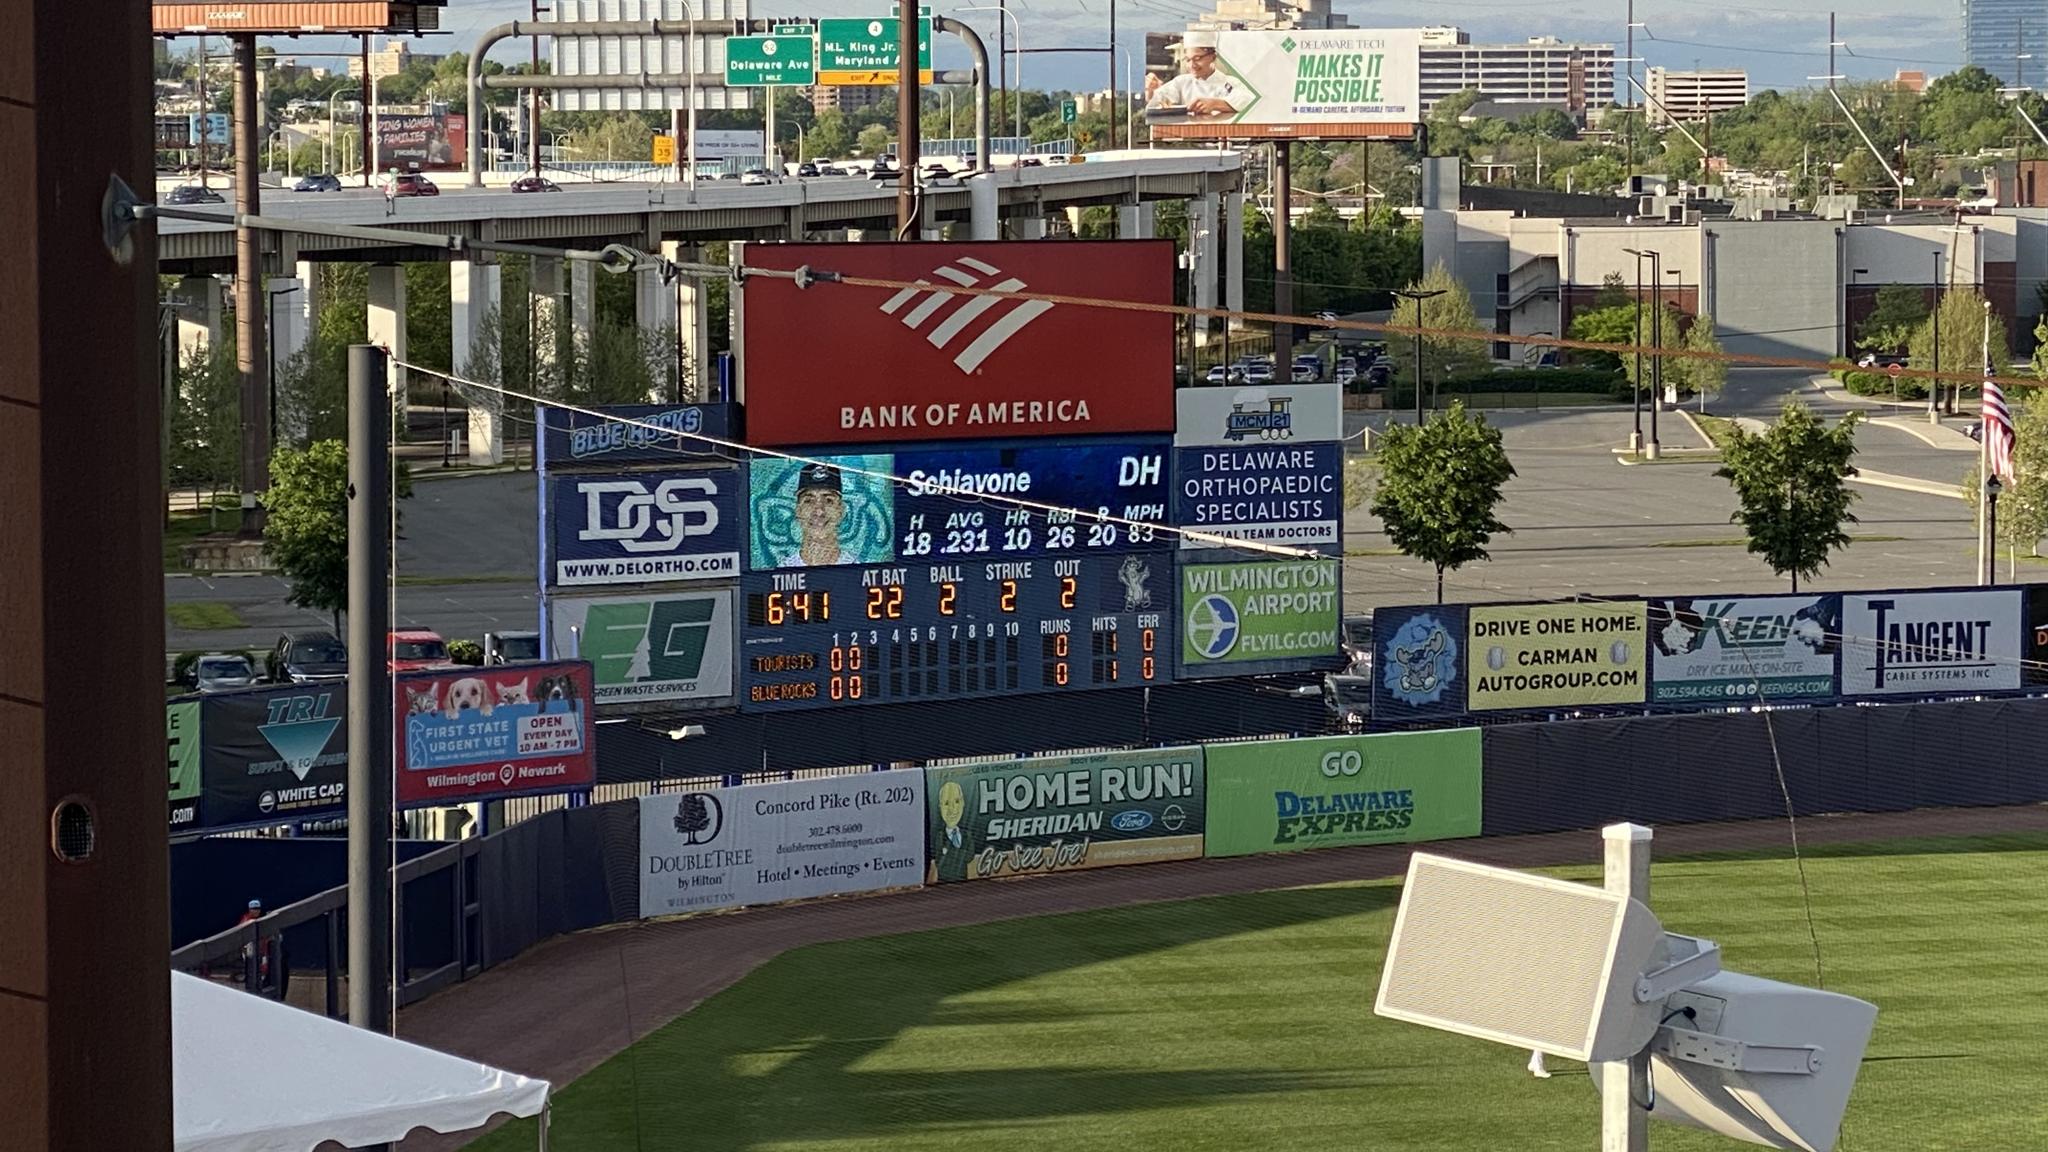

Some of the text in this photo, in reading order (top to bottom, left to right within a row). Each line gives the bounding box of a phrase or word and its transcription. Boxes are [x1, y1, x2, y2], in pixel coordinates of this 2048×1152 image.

[850, 42, 876, 54] King
[881, 42, 896, 52] Jr.
[1300, 39, 1385, 50] DELAWARE TECH
[731, 59, 809, 70] Delaware Ave
[835, 55, 889, 67] Maryland
[1297, 54, 1384, 78] MAKES IT
[759, 73, 763, 82] 1
[1294, 79, 1384, 103] POSSIBLE.
[403, 116, 435, 129] WOMEN
[384, 131, 426, 144] FAMILIES
[657, 148, 671, 157] 35
[840, 400, 1091, 429] BANK OF AMERICA
[1236, 415, 1287, 427] MCM 21
[572, 408, 700, 456] BLUE ROCKS
[1203, 450, 1315, 472] DELAWARE
[907, 455, 1162, 496] Schiavone DH
[1184, 474, 1333, 498] ORTHOPAEDIC
[578, 477, 719, 552] DOS
[910, 514, 924, 531] H
[945, 512, 984, 529] AVG
[1005, 510, 1030, 526] HR
[1097, 506, 1110, 522] R
[1123, 504, 1164, 520] MPH
[1196, 500, 1323, 522] SPECIALISTS
[902, 523, 1154, 555] 18 .231 10 26 20 83
[1243, 526, 1332, 539] TEAM DOCTORS
[564, 558, 733, 578] WWW.DELORTHO.COM
[772, 559, 1081, 591] TIME AT BAT BALL STRIKE OUT
[1187, 564, 1336, 593] WILMINGTON
[768, 578, 1076, 625] 6:41 22 2 2 2
[1244, 591, 1336, 616] AIRPORT
[833, 614, 1159, 646] 1 2 3 4 5 6 7 8 9 10 RUNS HITS ERR
[1475, 616, 1641, 637] DRIVE ONE HOME.
[1696, 602, 1796, 650] KEEN
[756, 629, 1154, 673] TOURISTS 0 0 0 1 0
[1241, 631, 1335, 652] FLYILG.COM
[1867, 600, 1991, 689] TANGENT
[1518, 648, 1598, 666] CARMAN
[1686, 661, 1803, 677] DRY ICE MADE ON-SITE
[831, 676, 843, 700] 0
[849, 675, 861, 699] 0
[1056, 662, 1068, 685] 0
[1112, 660, 1118, 680] 1
[1142, 657, 1154, 680] 0
[1477, 670, 1638, 692] AUTOGROUP.COM
[1886, 669, 1990, 681] CABLE SYSTEMS INC
[624, 684, 655, 696] WASTE
[655, 682, 698, 693] SERVICES
[267, 693, 332, 725] TRI
[425, 720, 509, 739] FIRST STATE
[523, 728, 573, 741] EVERY DAY
[530, 716, 562, 729] OPEN
[429, 735, 509, 753] URGENT VET
[519, 739, 578, 753] 10 AM 7 PM
[427, 763, 566, 788] Wilmington Newark
[1321, 750, 1363, 779] GO
[277, 786, 317, 803] WHITE
[978, 762, 1194, 814] HOME RUN!
[755, 787, 914, 817] Concord Pike (Rt. 202)
[1275, 789, 1414, 818] DELAWARE
[986, 811, 1104, 841] SHERIDAN
[1118, 813, 1146, 828] Ford
[1273, 809, 1414, 845] EXPRESS
[976, 838, 1090, 876] Go See Joe!
[757, 856, 915, 884] Hotel Meetings Events
[678, 875, 722, 891] by Hilton
